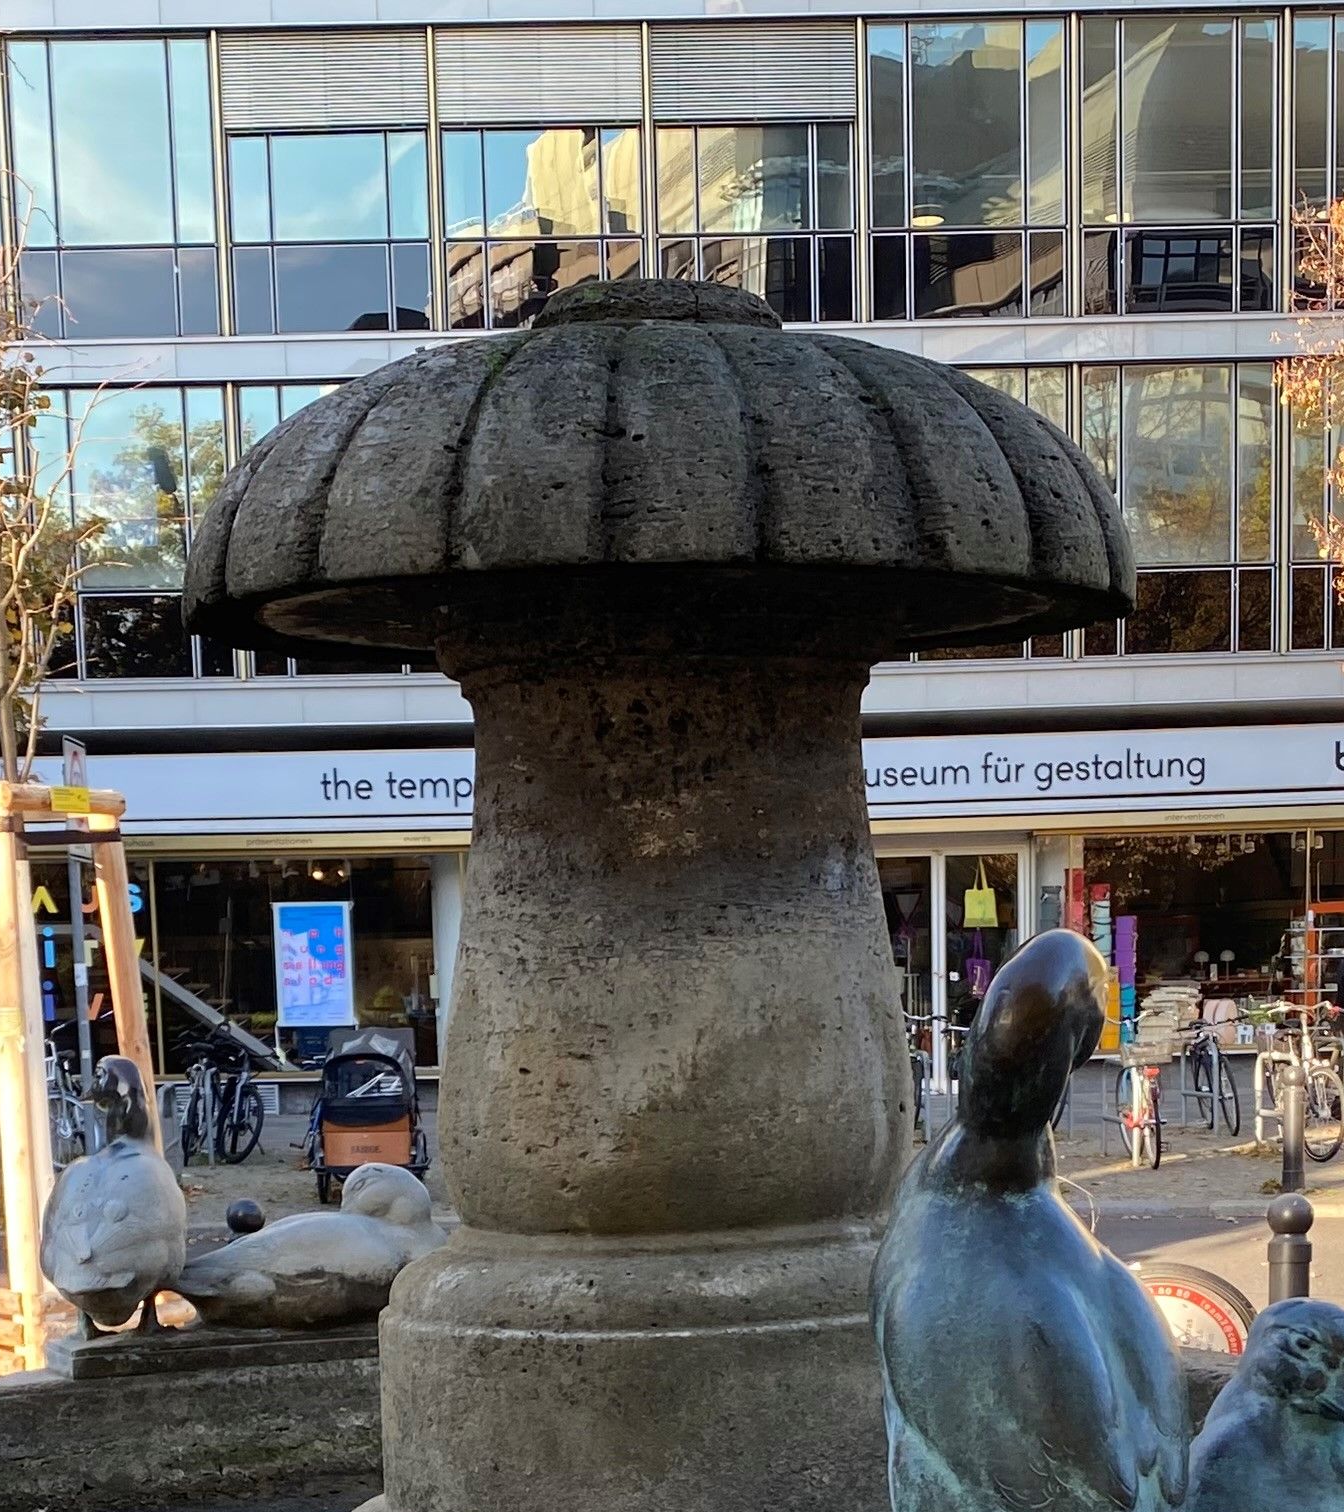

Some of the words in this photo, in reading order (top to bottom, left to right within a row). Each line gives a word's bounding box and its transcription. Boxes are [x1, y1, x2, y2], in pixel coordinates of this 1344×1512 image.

[320, 767, 373, 800] the
[386, 771, 473, 807] temp
[864, 764, 969, 788] useum
[982, 751, 1025, 785] für
[1034, 748, 1205, 791] gestaltung
